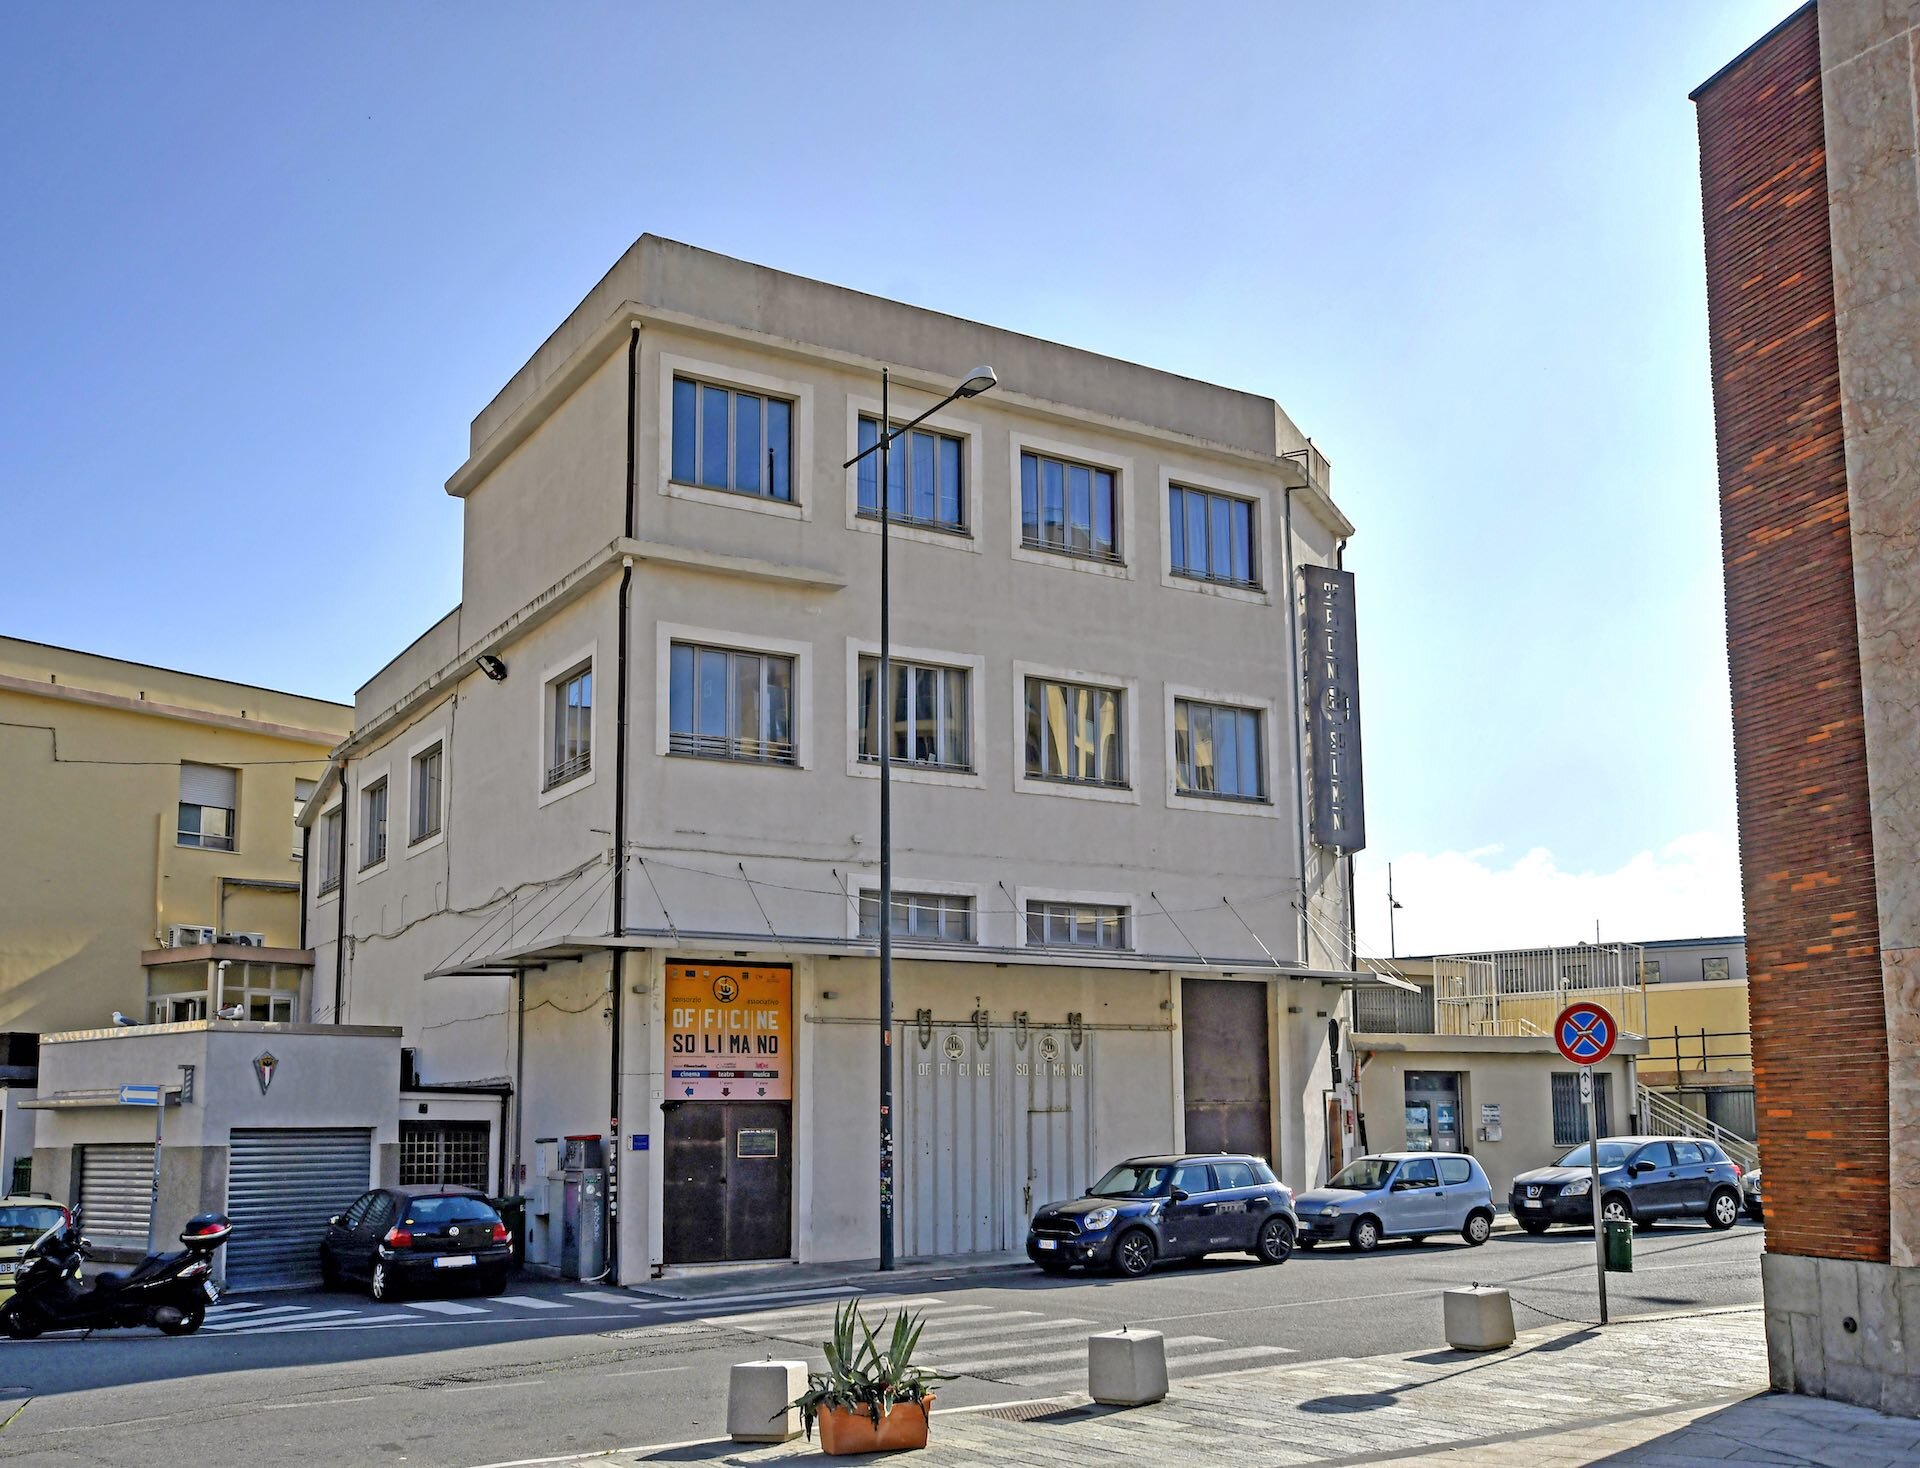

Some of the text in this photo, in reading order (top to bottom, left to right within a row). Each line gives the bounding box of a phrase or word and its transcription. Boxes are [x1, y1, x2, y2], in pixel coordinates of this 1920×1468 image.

[680, 1070, 701, 1078] cinema
[718, 1070, 735, 1078] teatro
[752, 1070, 771, 1078] musica
